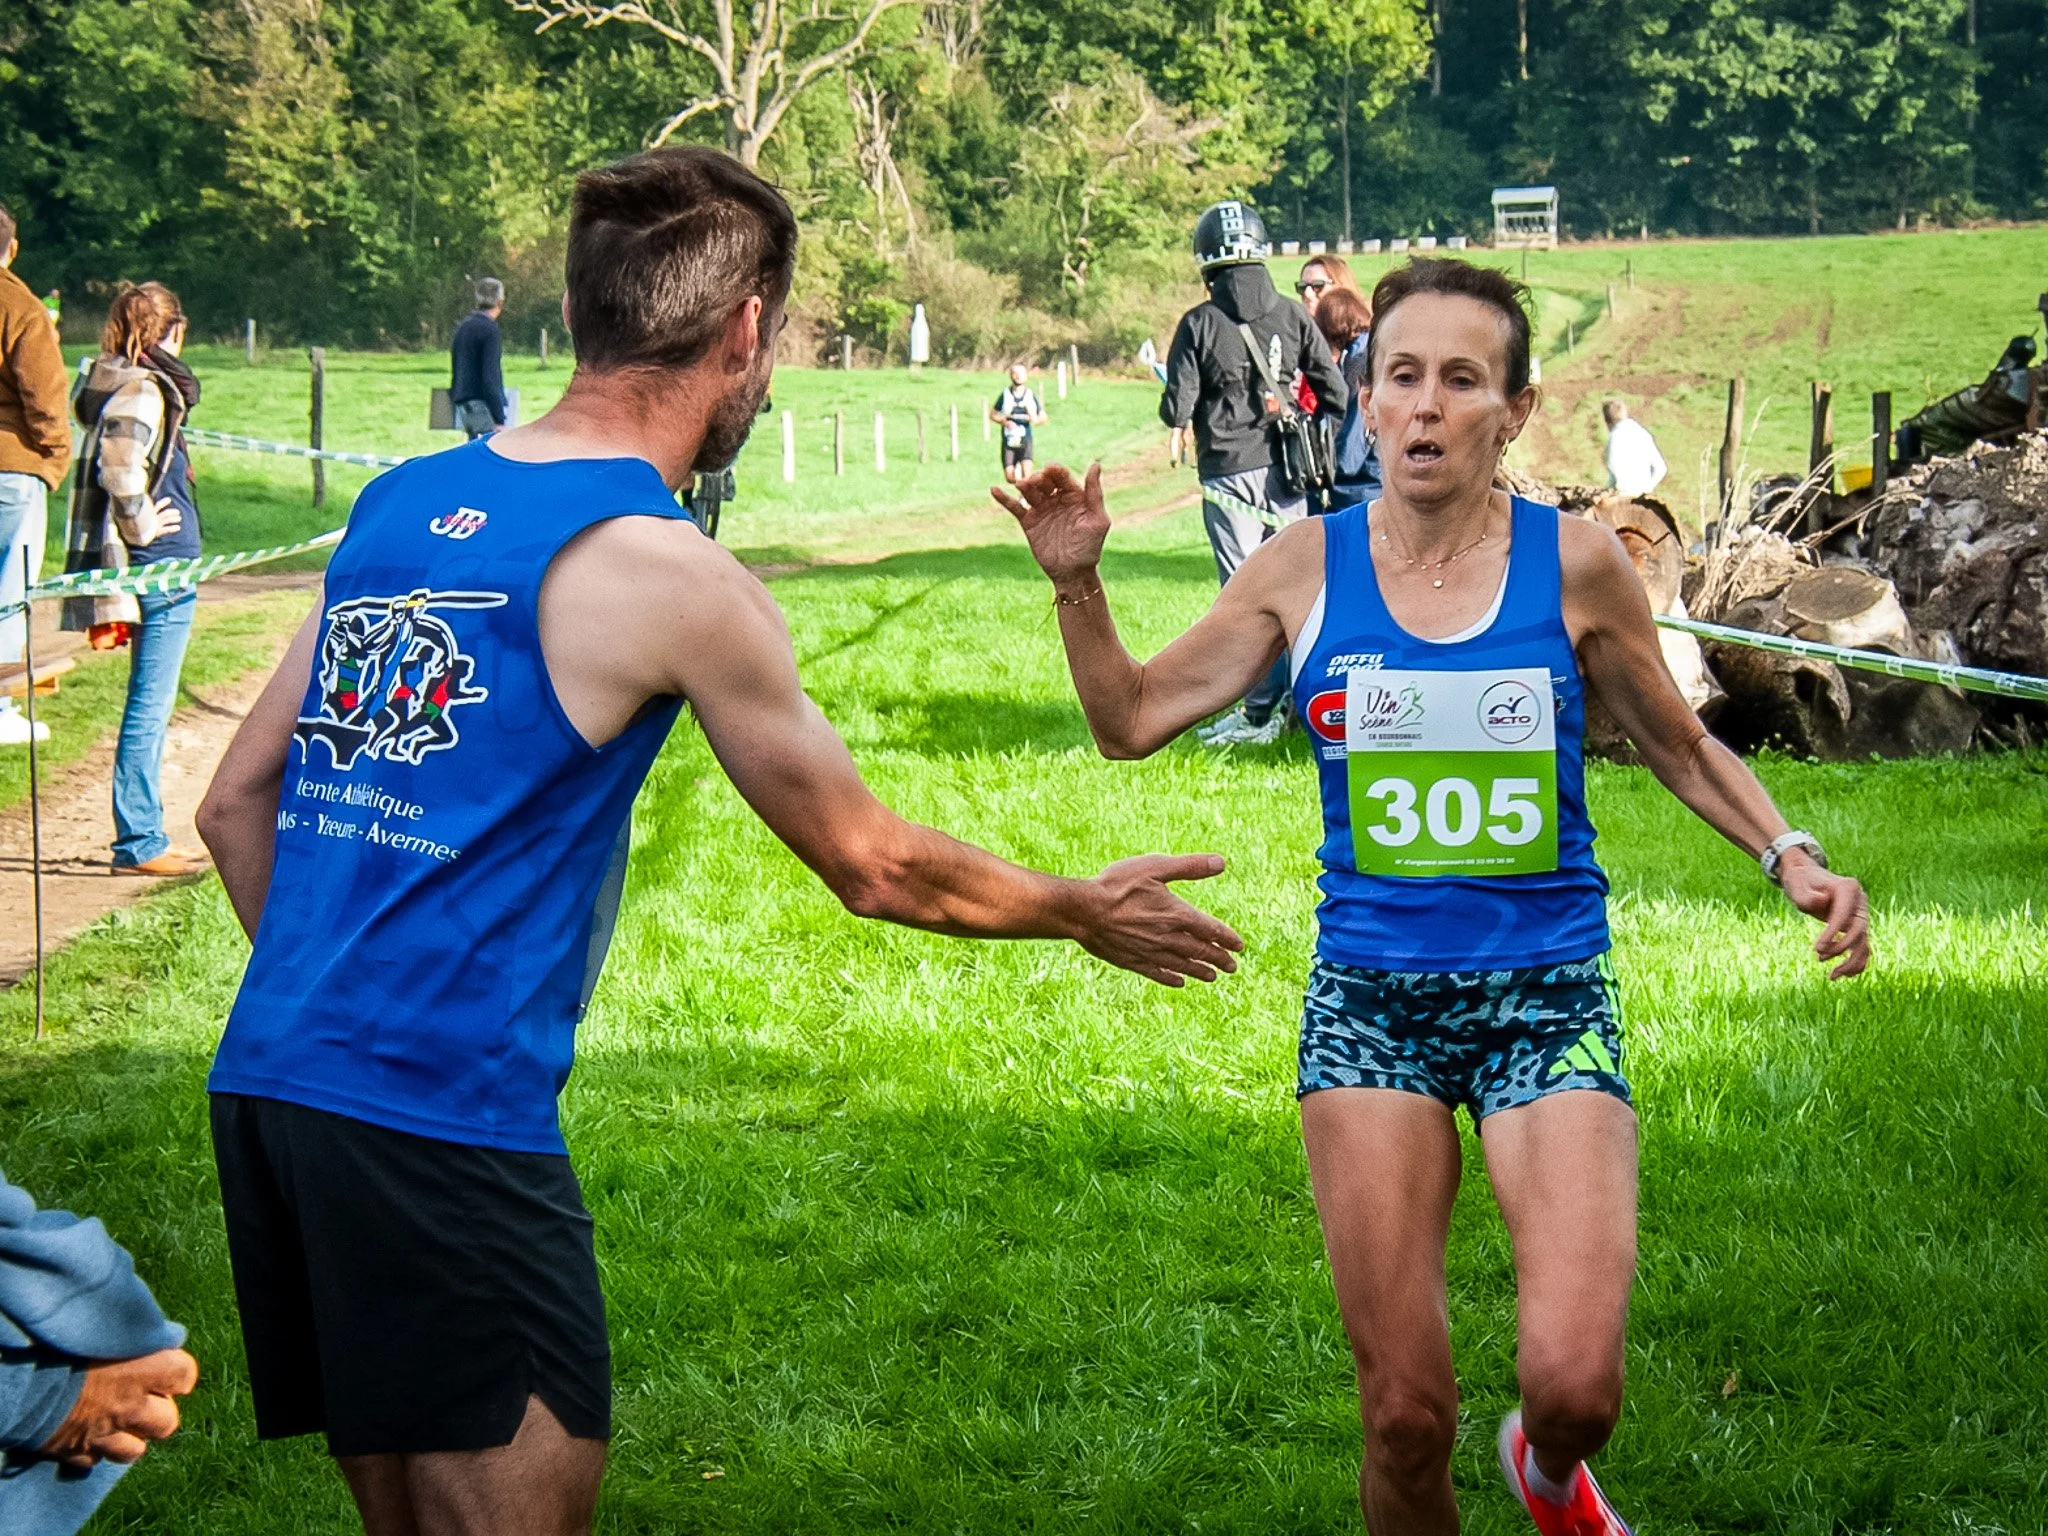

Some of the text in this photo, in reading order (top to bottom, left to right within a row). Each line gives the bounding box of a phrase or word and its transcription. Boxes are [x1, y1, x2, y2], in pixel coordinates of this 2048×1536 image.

[1329, 653, 1385, 666] DIFFU
[1366, 688, 1402, 715] Vin
[339, 782, 424, 821] Athlétique
[1365, 776, 1544, 848] 305
[317, 812, 357, 840] Yzeure
[365, 821, 462, 863] Avermes
